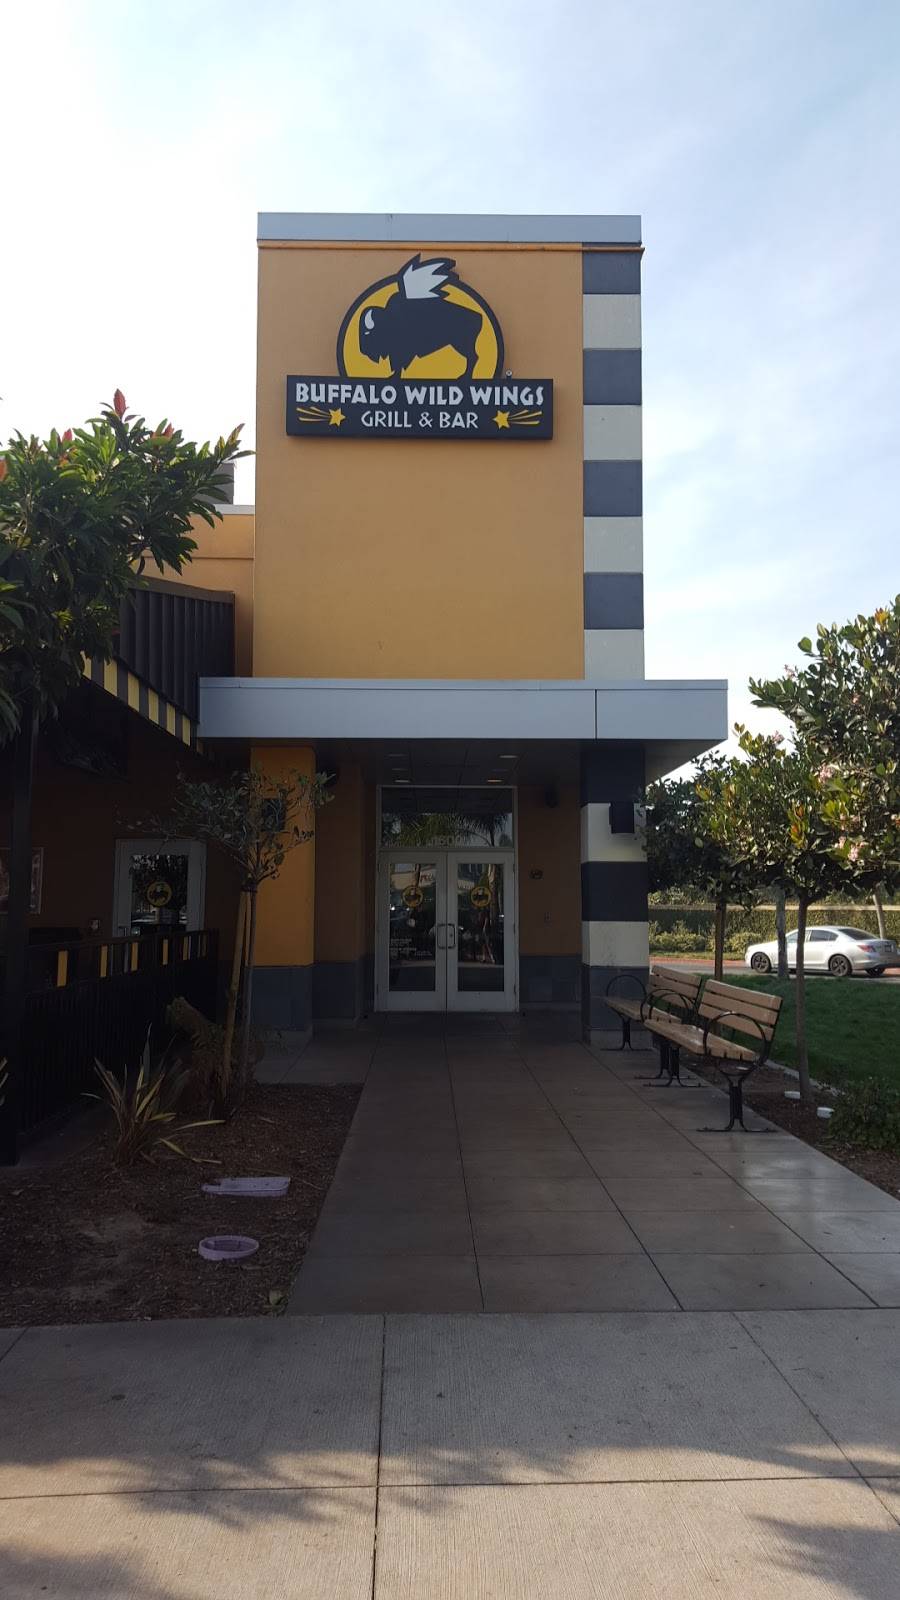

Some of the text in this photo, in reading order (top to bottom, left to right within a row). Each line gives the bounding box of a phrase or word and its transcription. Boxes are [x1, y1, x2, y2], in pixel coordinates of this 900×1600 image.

[295, 383, 544, 406] BUFFALO WILD WINGS
[361, 410, 479, 429] GRILL & BAR
